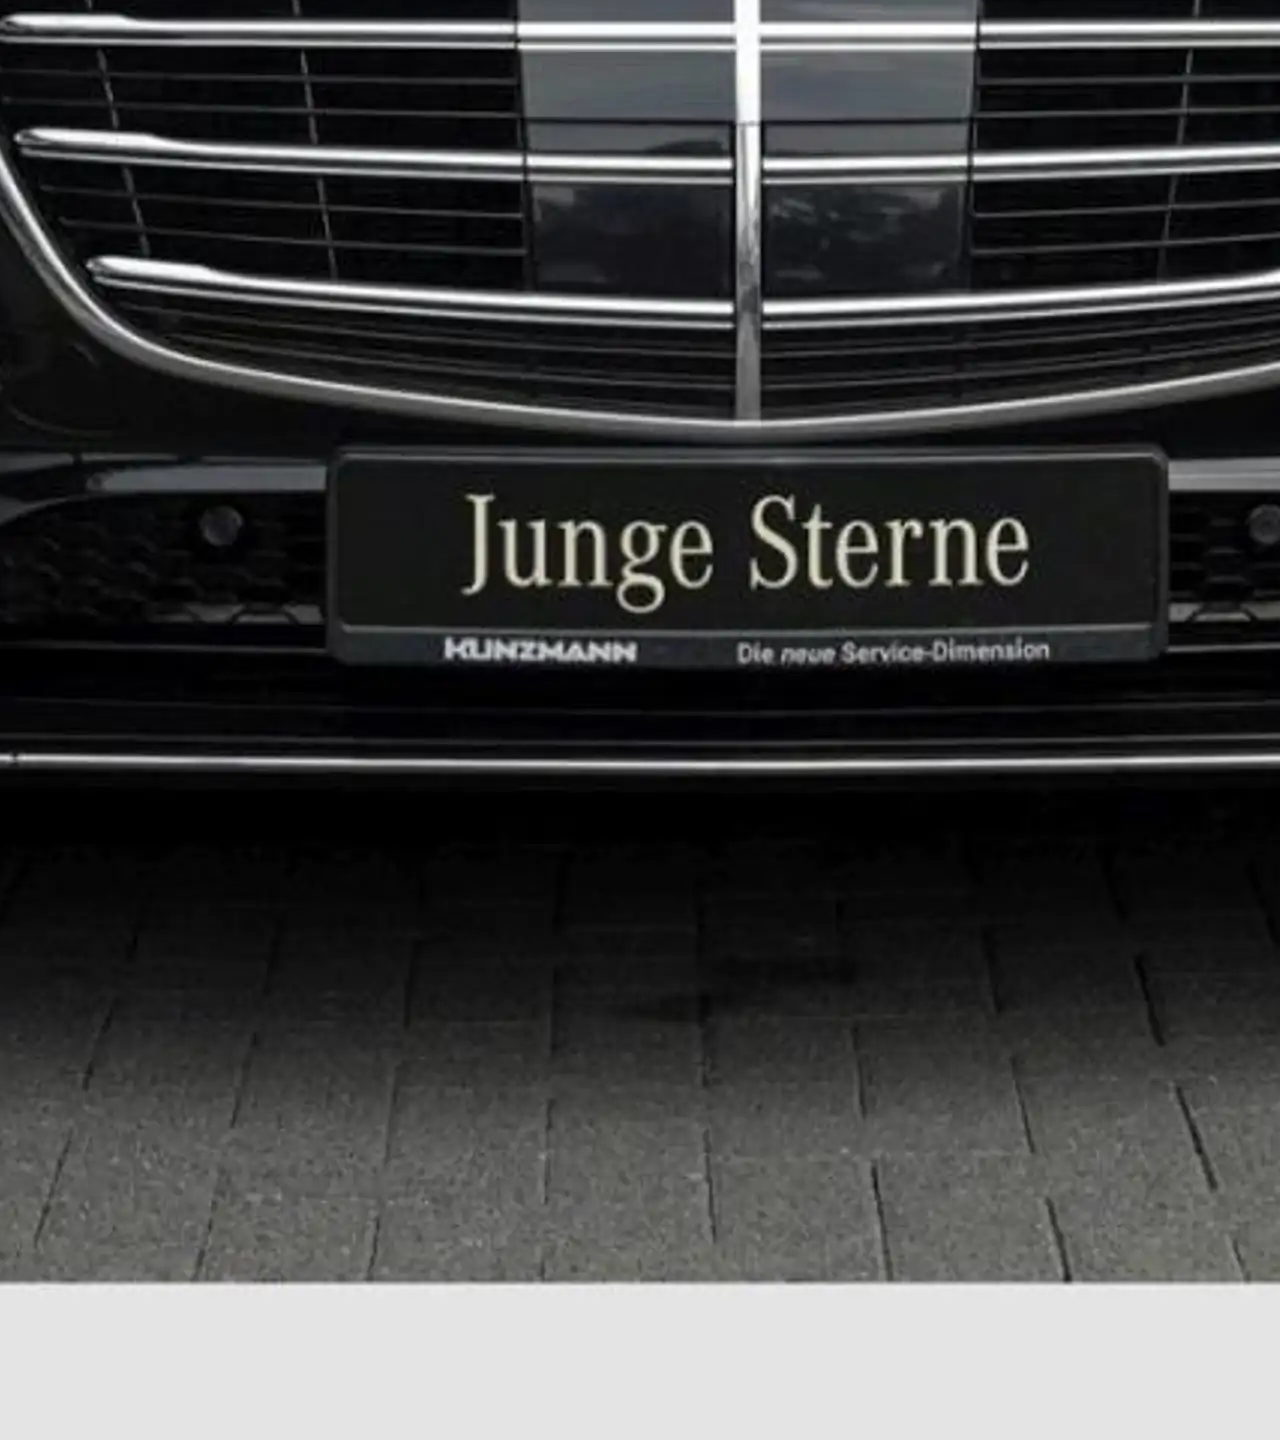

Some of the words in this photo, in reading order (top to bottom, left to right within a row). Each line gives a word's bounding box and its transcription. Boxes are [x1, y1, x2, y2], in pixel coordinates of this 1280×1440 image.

[460, 493, 715, 613] Junge
[749, 493, 1030, 591] Sterne
[444, 636, 638, 662] KUNZMANN
[736, 641, 775, 664] Die
[780, 645, 836, 664] neue
[841, 637, 1051, 664] Service-Dimension
